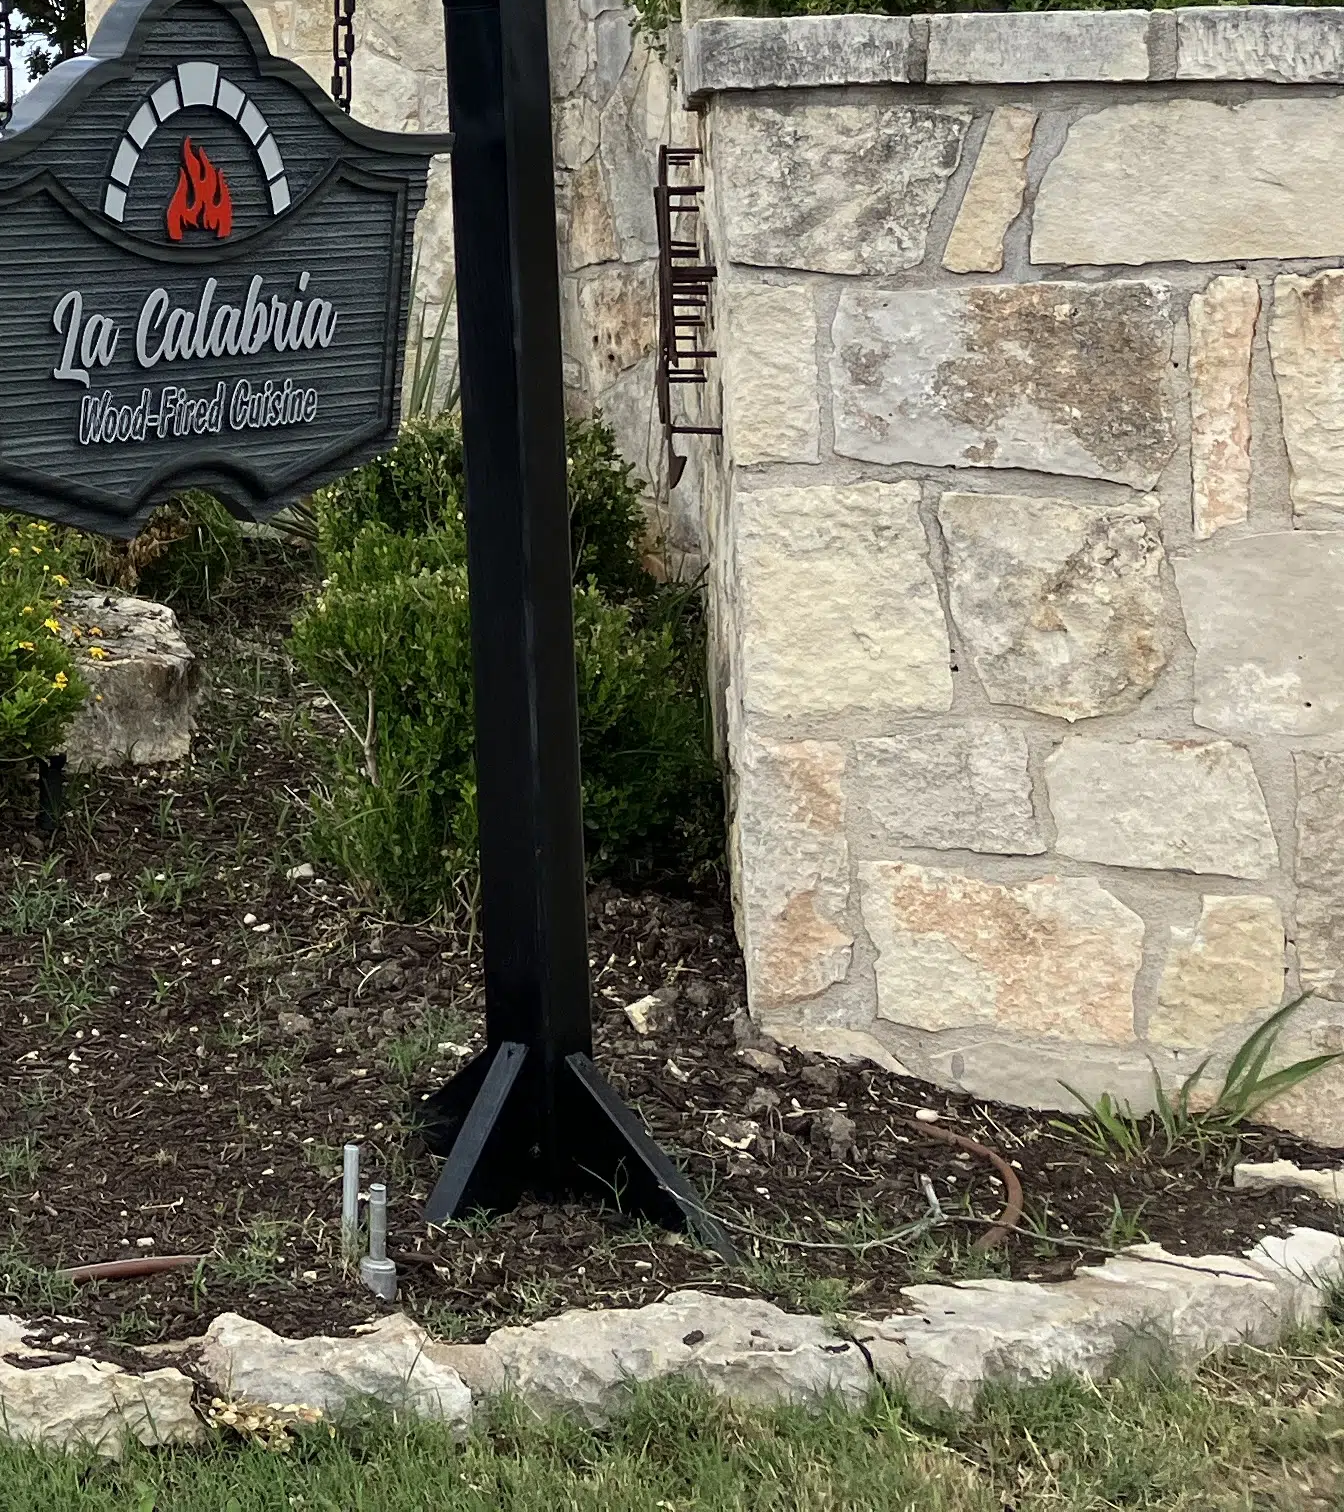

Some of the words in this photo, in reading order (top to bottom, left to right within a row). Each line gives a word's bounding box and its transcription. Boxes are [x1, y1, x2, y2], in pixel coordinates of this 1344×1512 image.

[52, 290, 119, 389] La
[136, 271, 338, 368] Calabria
[79, 380, 226, 445] Wood-Fired
[230, 378, 318, 430] Cuisine
